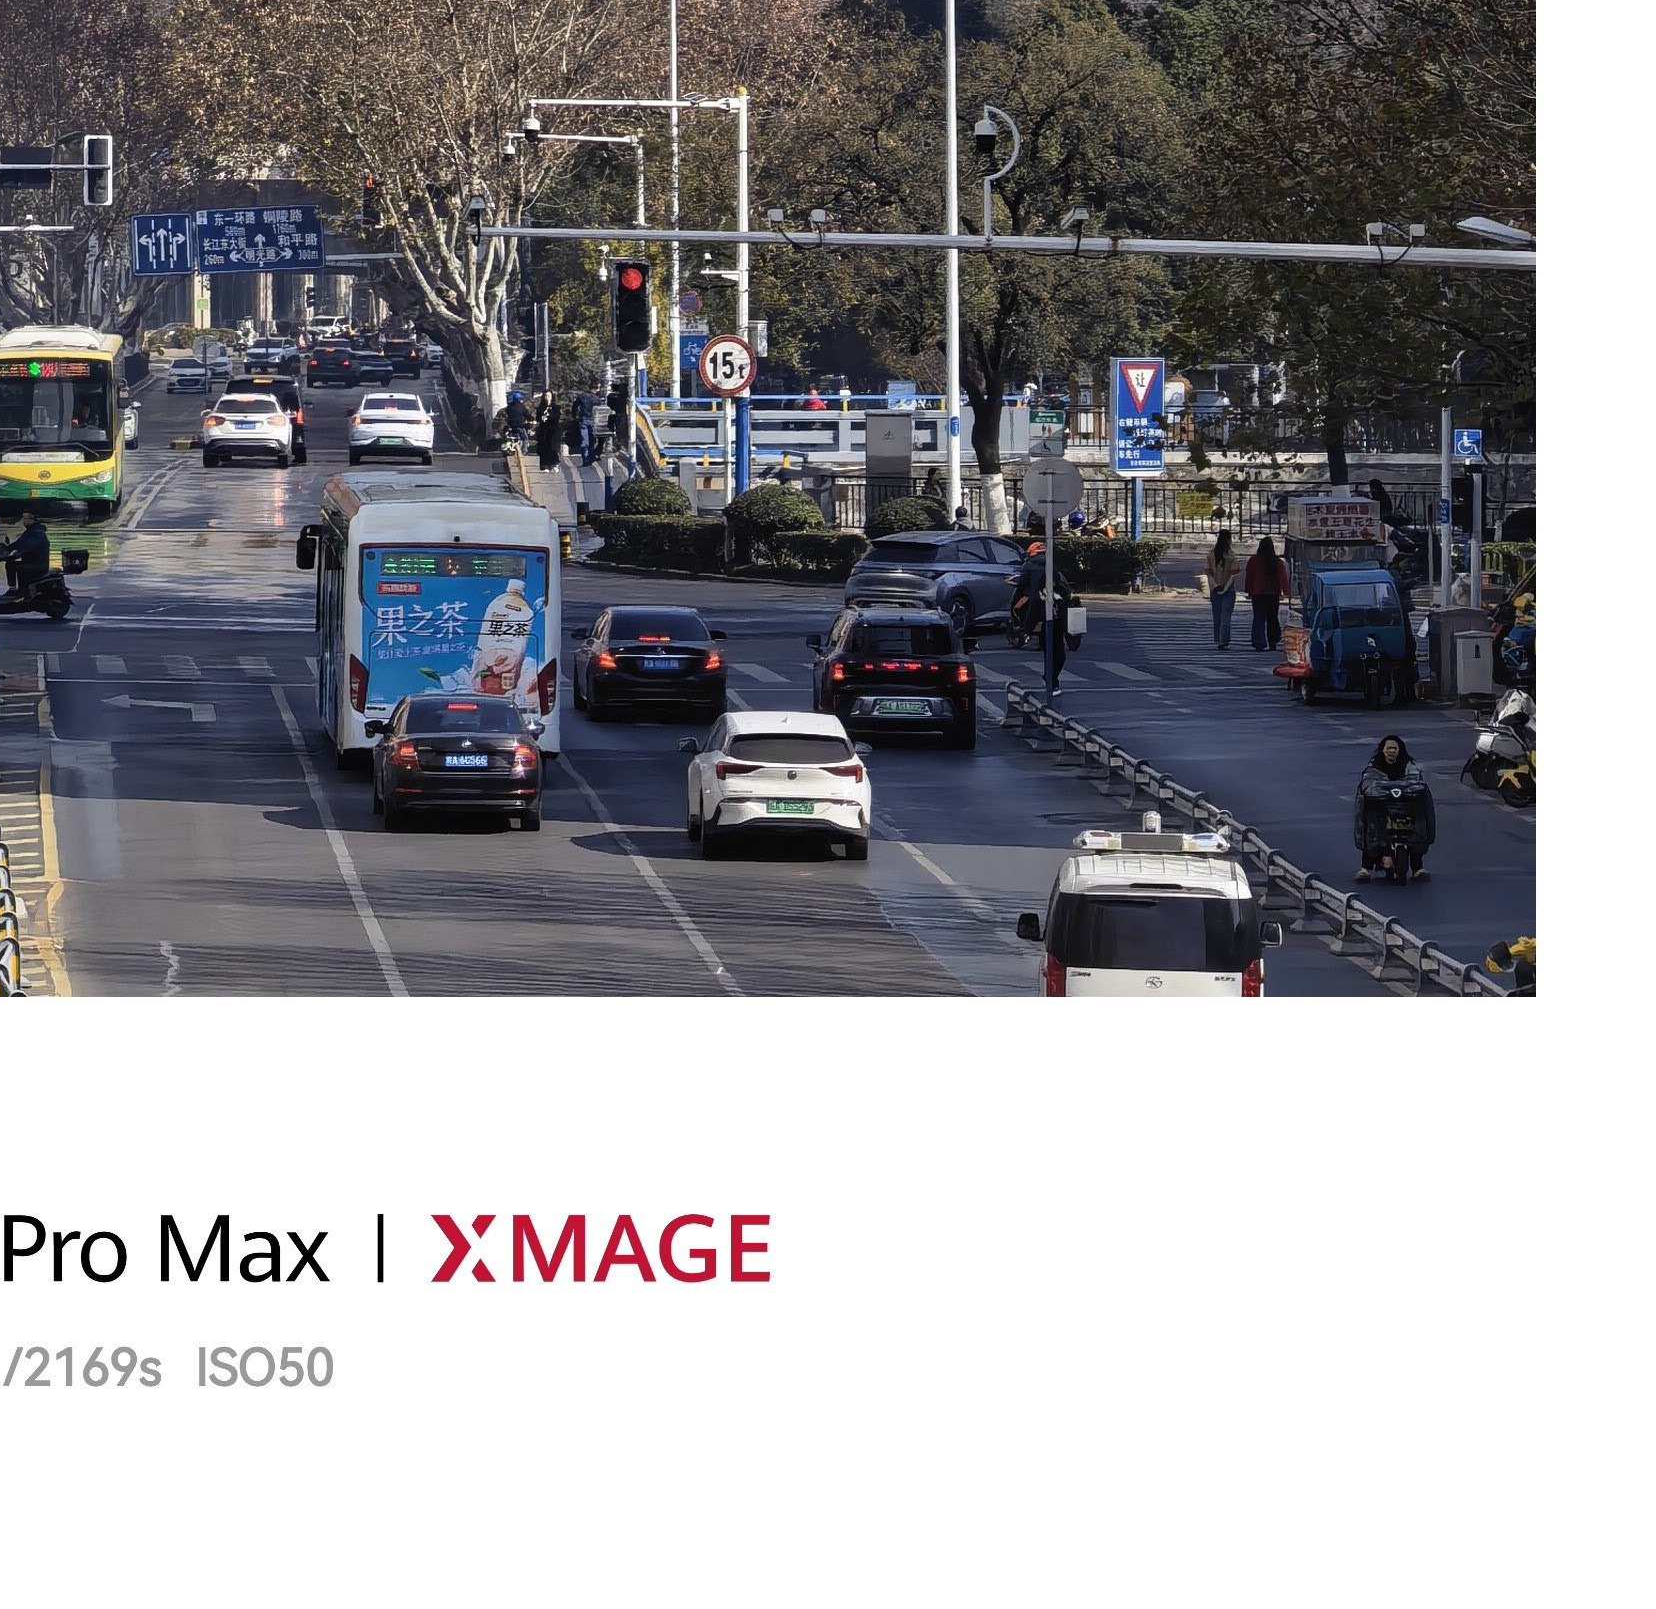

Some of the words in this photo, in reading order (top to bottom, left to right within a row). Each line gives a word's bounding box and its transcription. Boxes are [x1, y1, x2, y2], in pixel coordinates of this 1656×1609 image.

[213, 212, 256, 227] 东一环路
[262, 208, 303, 224] 铜陵路
[202, 237, 247, 251] 长江东大街
[277, 233, 319, 247] 和平路
[1135, 372, 1146, 388] 让
[371, 601, 469, 648] 果之茶
[487, 620, 529, 638] 果之茶
